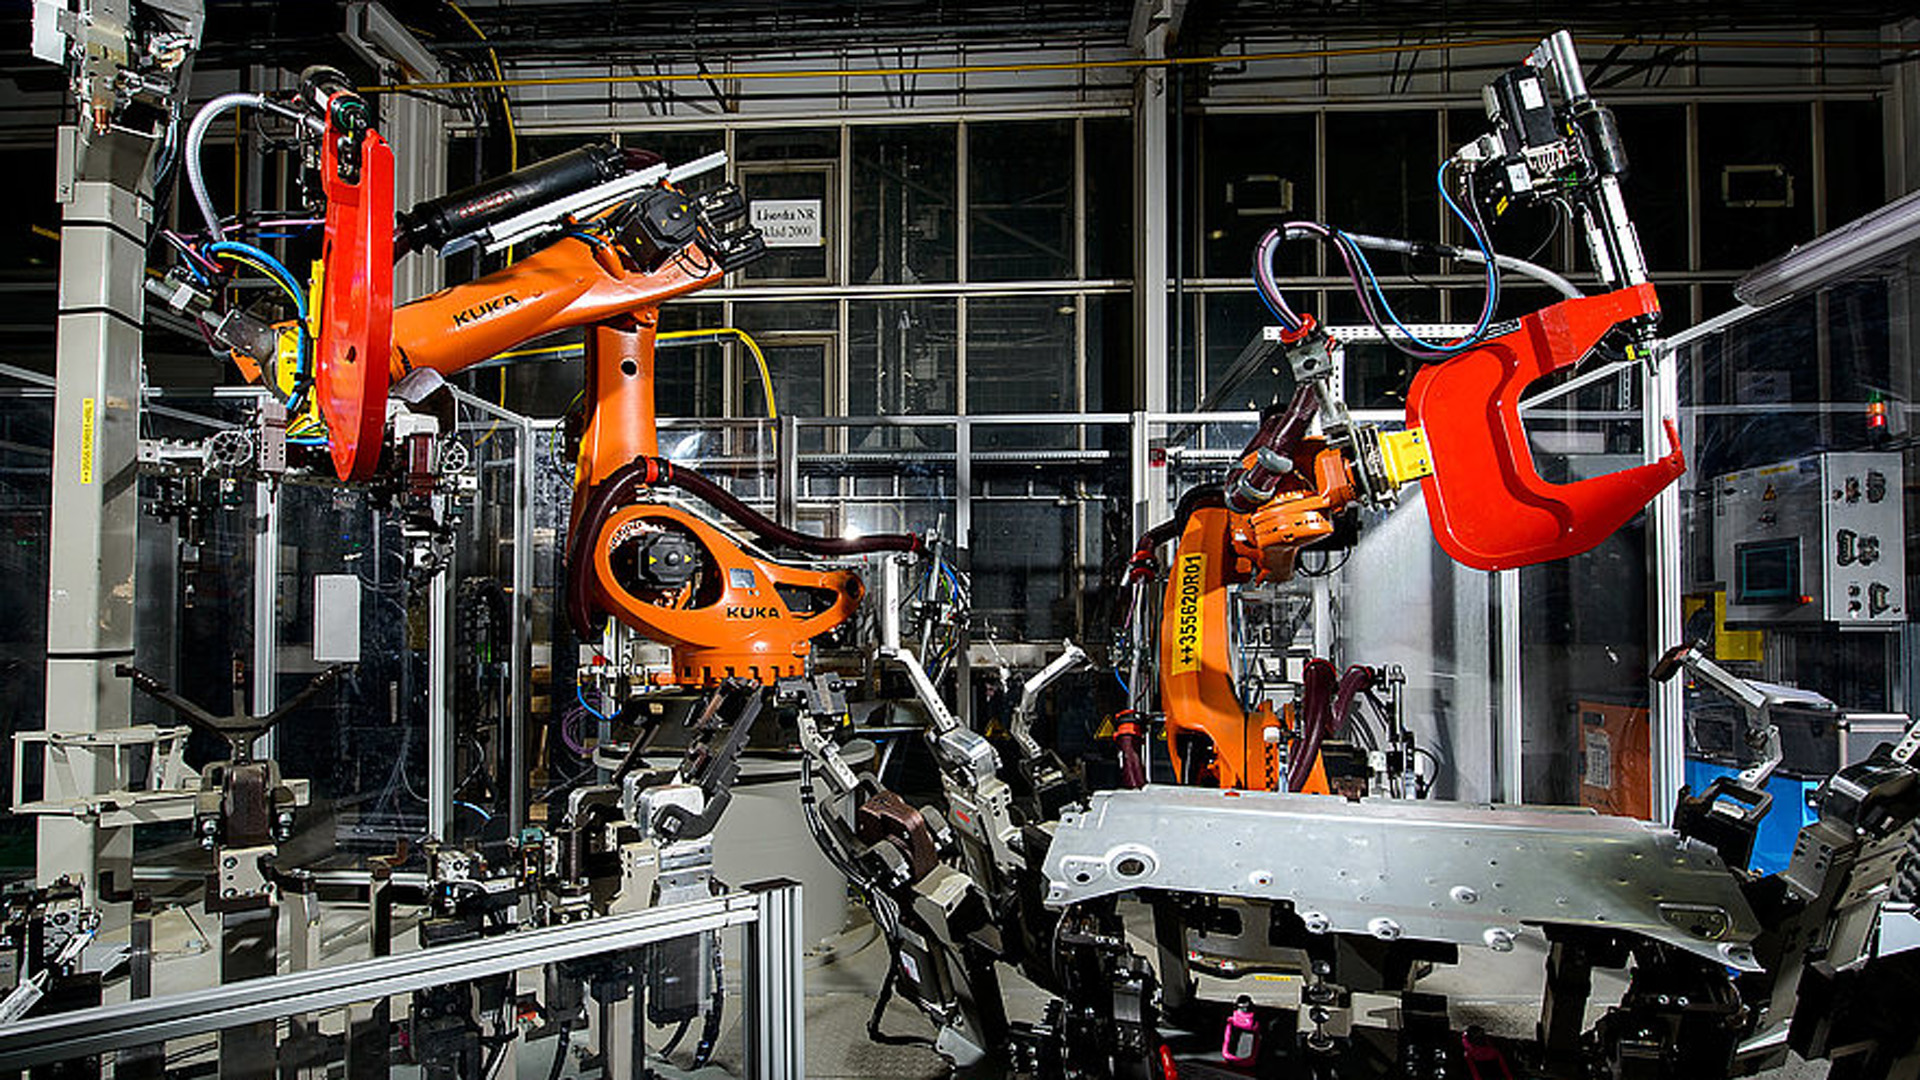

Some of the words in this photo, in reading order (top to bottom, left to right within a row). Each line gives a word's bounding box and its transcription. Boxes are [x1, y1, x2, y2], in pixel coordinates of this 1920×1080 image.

[797, 208, 816, 221] NR
[762, 226, 787, 238] klad
[789, 226, 813, 238] 2000
[453, 295, 519, 327] KUKA
[727, 607, 781, 619] KUKA
[1179, 555, 1203, 665] ++355620R01
